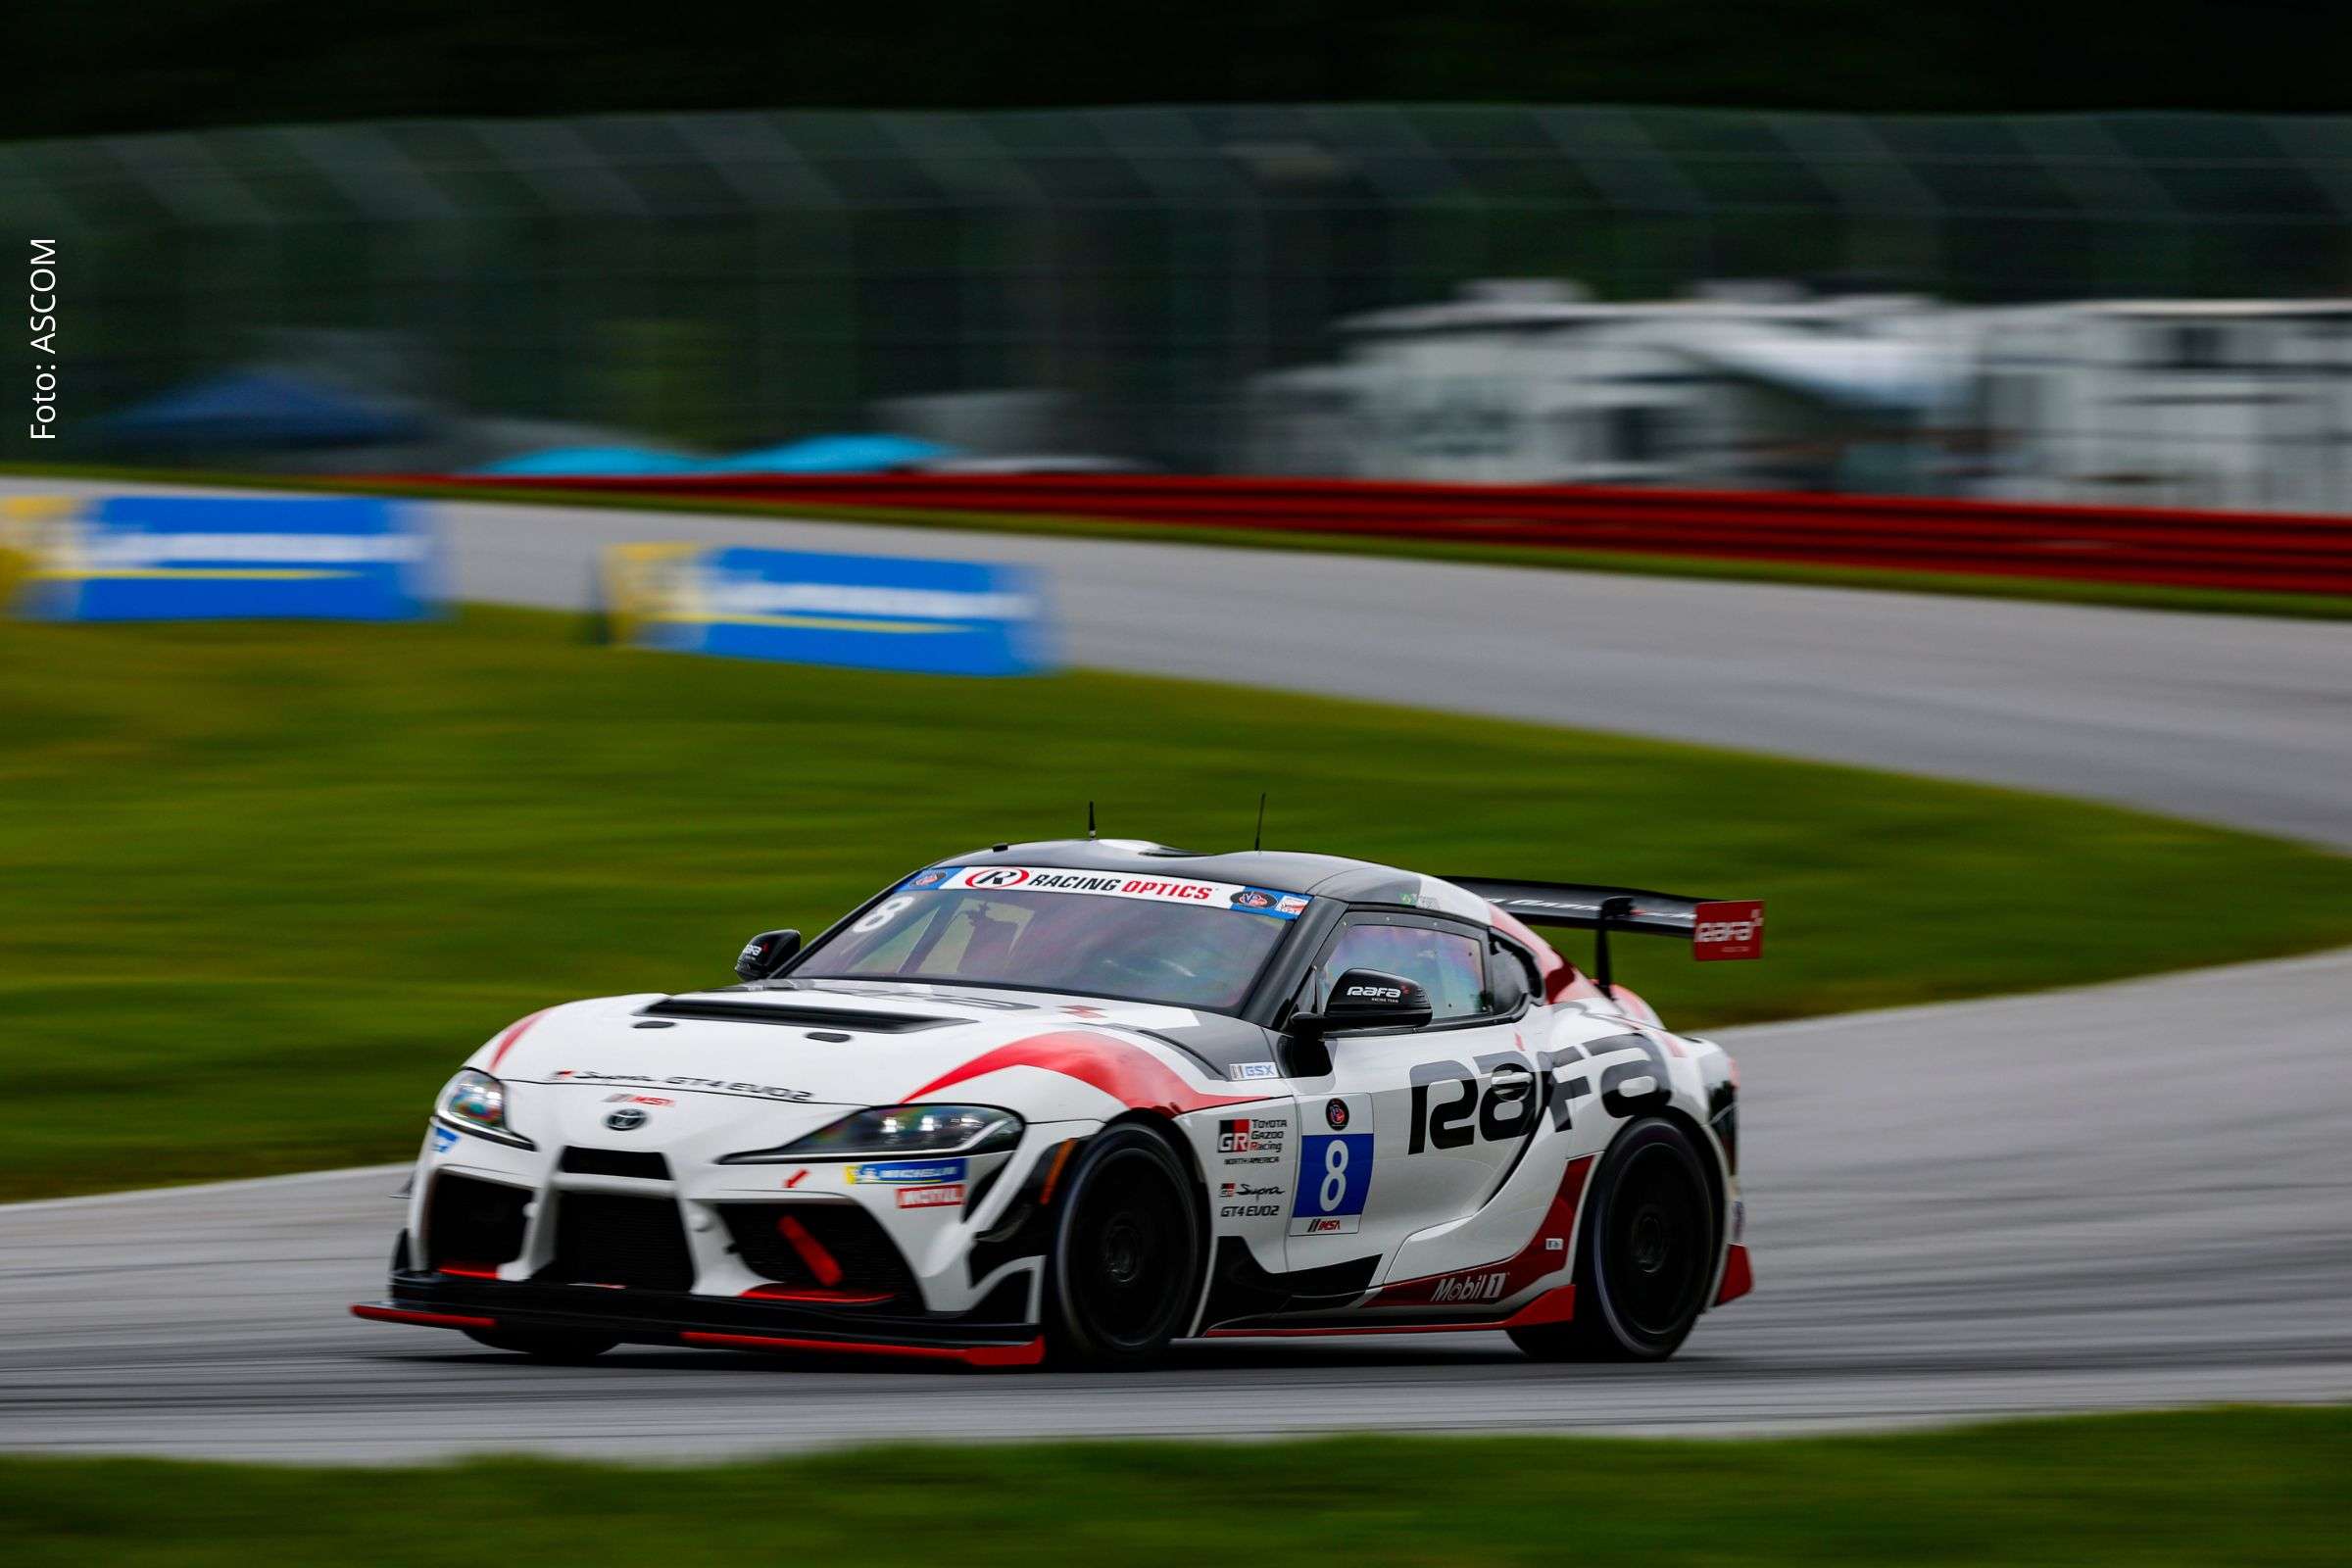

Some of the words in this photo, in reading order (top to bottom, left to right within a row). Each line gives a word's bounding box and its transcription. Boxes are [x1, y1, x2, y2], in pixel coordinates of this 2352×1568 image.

[1030, 874, 1121, 891] RACING
[1121, 880, 1212, 900] OPTICS
[852, 896, 914, 933] 8
[1245, 1065, 1274, 1076] GSX
[1251, 1119, 1288, 1128] TOYOTA
[1219, 1132, 1249, 1152] GR
[1250, 1130, 1284, 1140] GAZOO
[1250, 1141, 1283, 1153] Racing
[1319, 1140, 1349, 1212] 8
[1236, 1183, 1286, 1201] Supra
[1430, 1275, 1488, 1302] Mobil
[1482, 1272, 1506, 1298] 1
